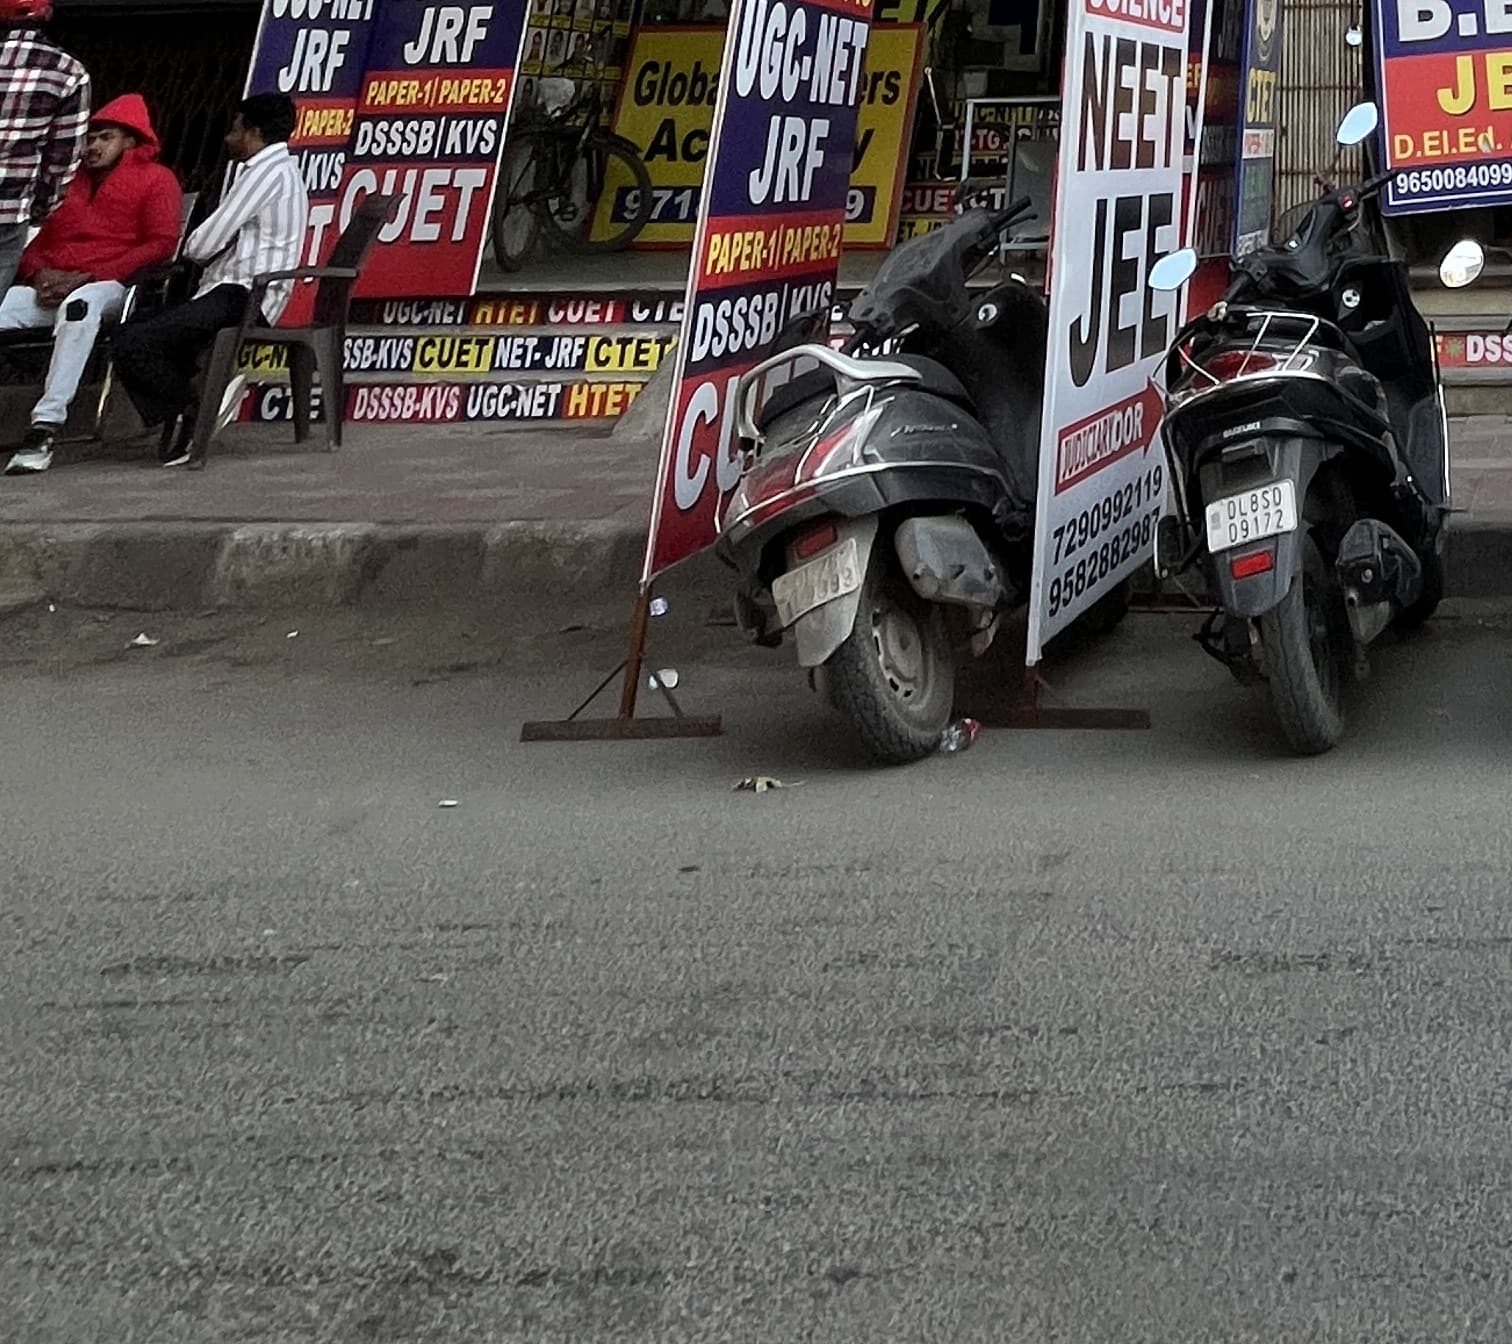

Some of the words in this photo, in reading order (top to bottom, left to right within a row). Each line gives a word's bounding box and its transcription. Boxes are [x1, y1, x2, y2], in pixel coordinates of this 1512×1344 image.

[278, 29, 350, 93] JRF
[403, 6, 493, 64] JRF
[1077, 31, 1183, 173] NEET
[748, 115, 830, 205] JRF
[417, 339, 493, 366] CUET
[545, 336, 586, 368] JRF
[593, 339, 678, 368] CTET
[353, 386, 461, 422] DSSSB-KVS
[466, 383, 559, 417] UGC-NET
